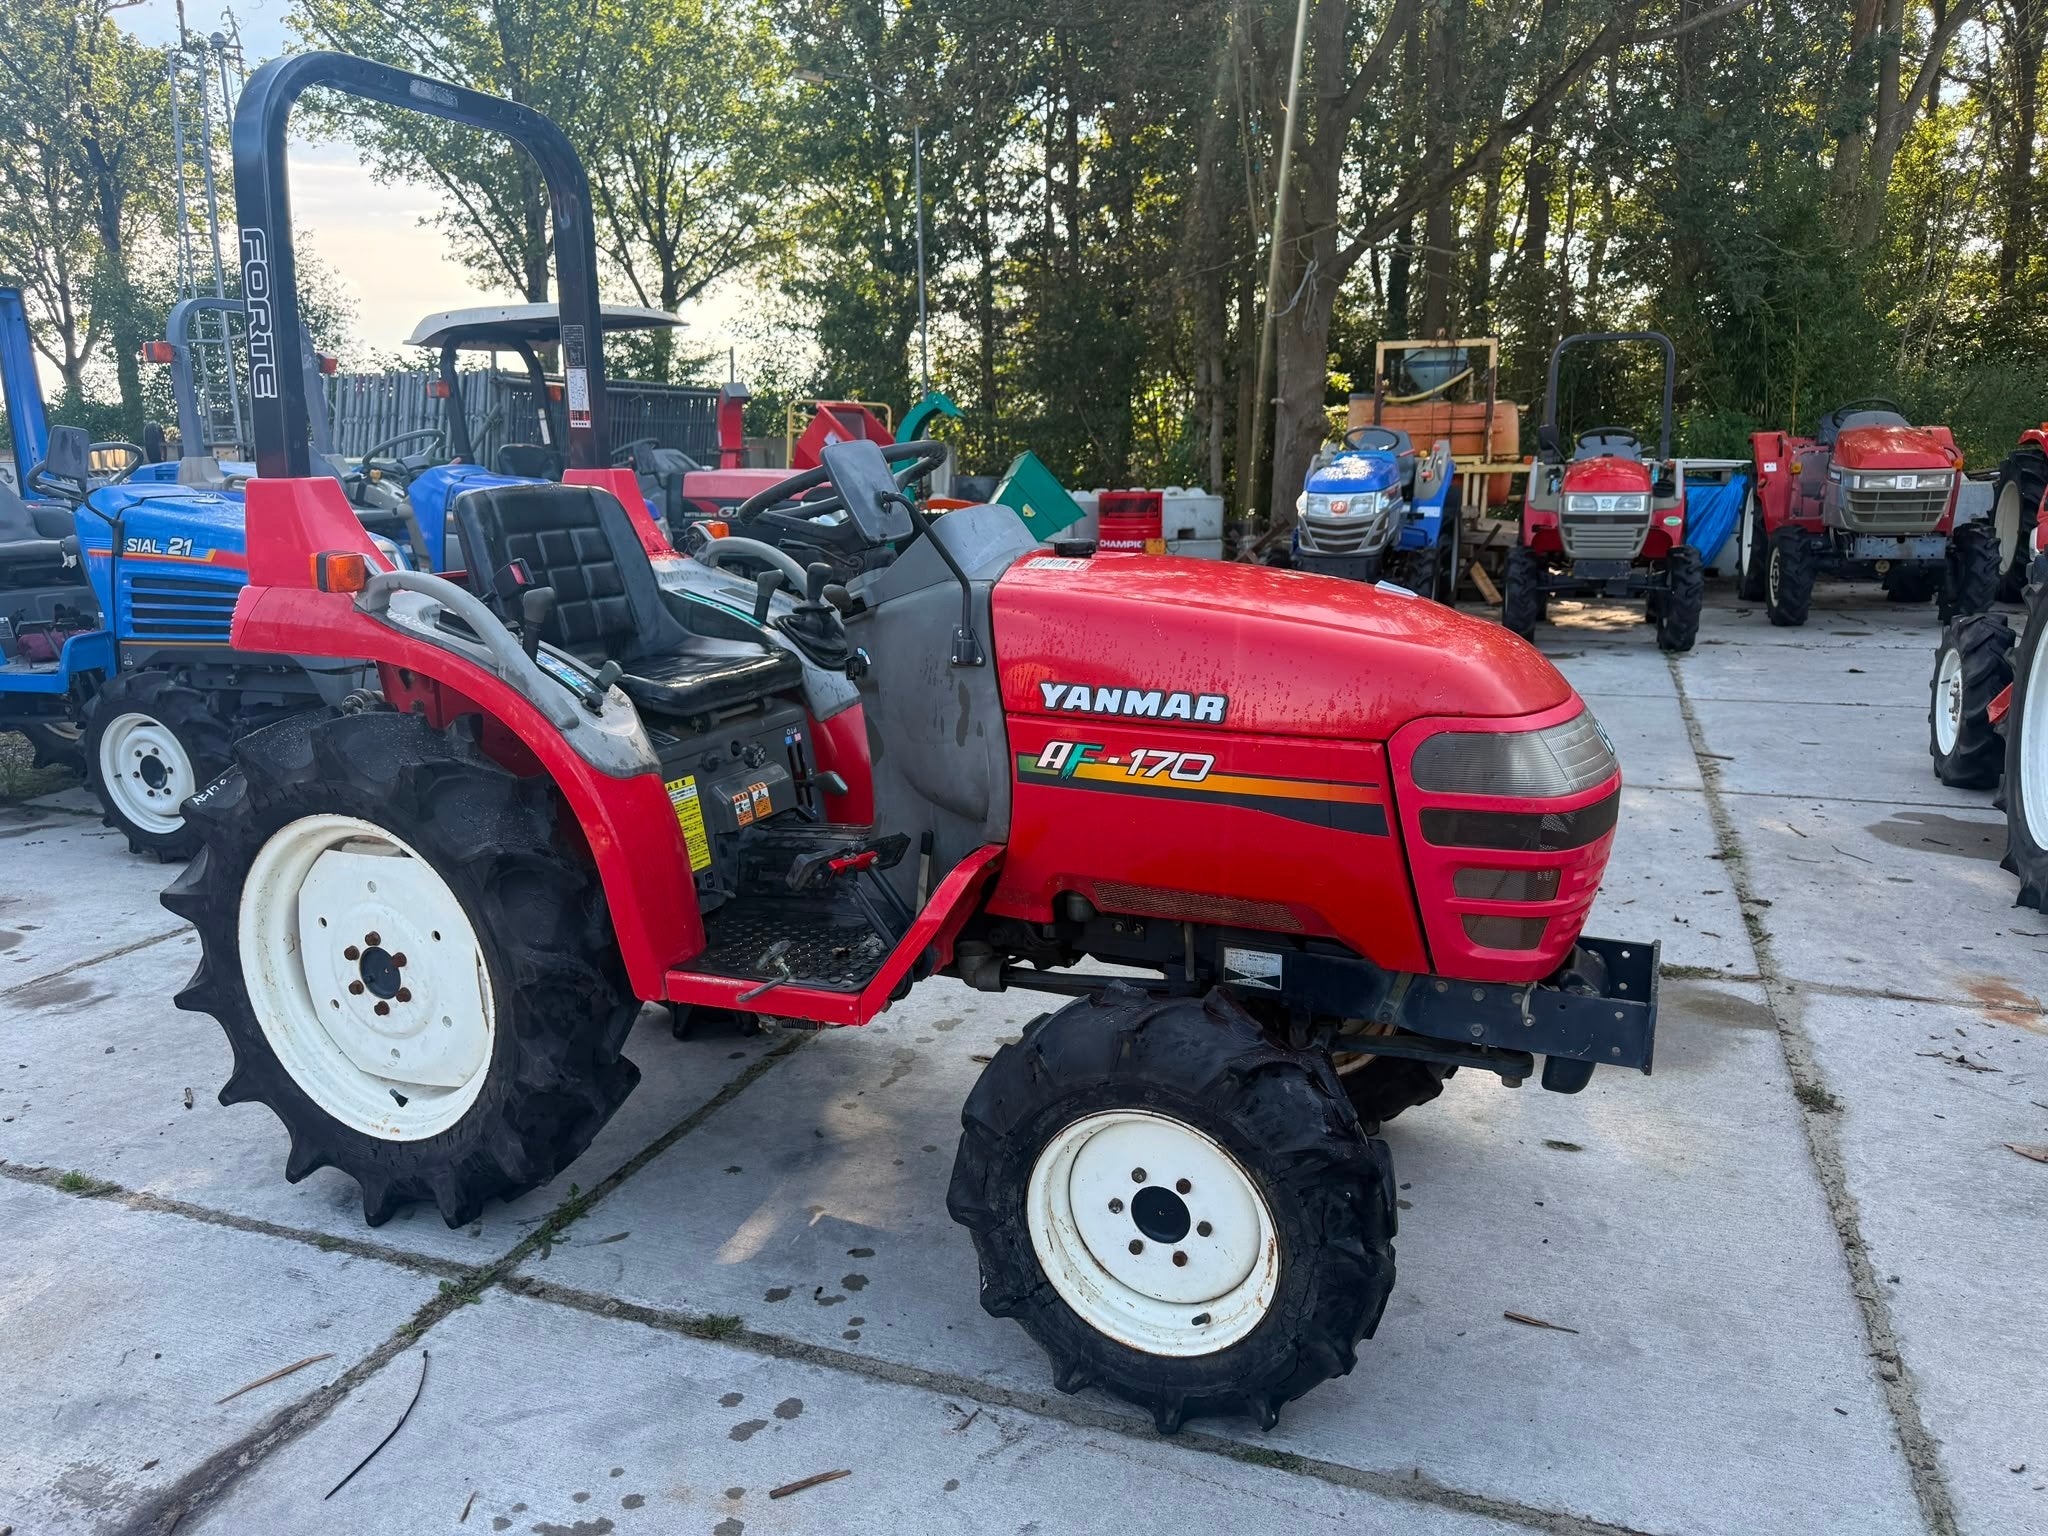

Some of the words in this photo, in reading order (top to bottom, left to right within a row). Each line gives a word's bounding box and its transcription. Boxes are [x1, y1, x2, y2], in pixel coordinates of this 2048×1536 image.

[241, 227, 278, 398] FORTE
[126, 537, 162, 555] SIAL
[167, 537, 194, 556] 21
[1040, 681, 1227, 723] YANMAR
[1035, 740, 1216, 781] AF-170
